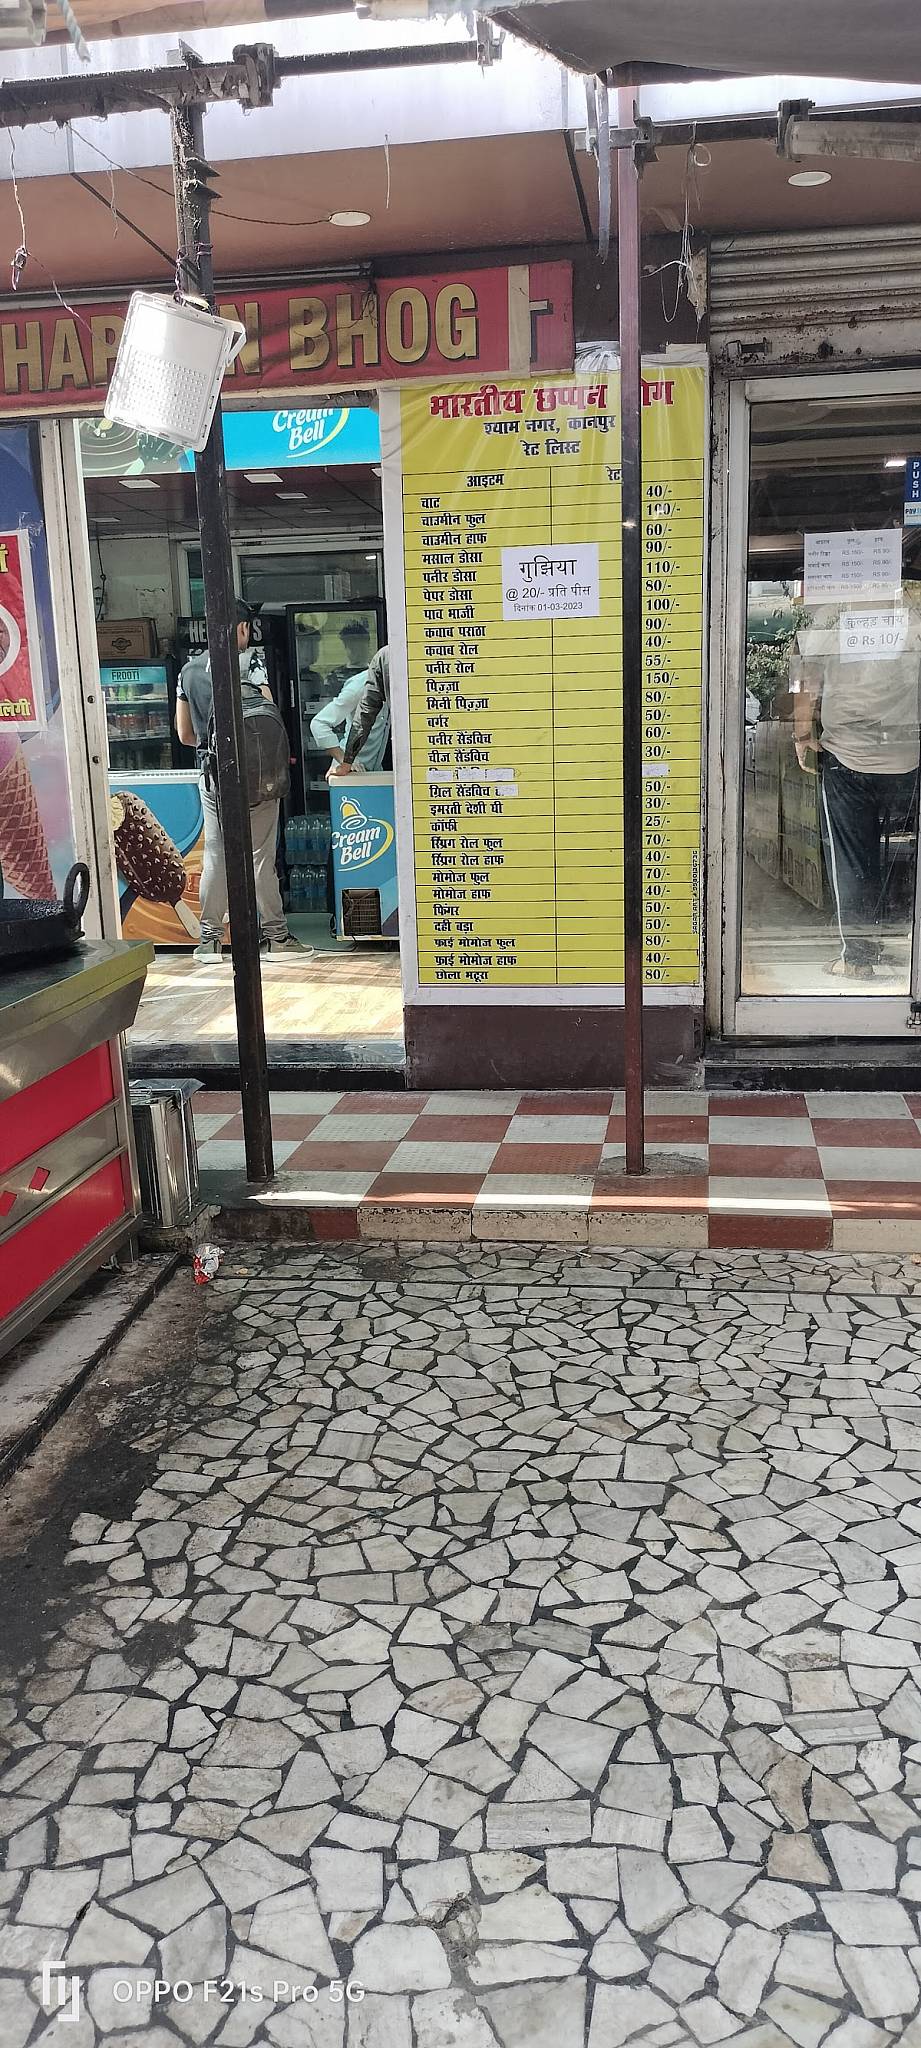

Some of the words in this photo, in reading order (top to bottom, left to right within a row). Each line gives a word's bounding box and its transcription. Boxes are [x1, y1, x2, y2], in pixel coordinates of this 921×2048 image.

[1, 302, 261, 393] HAPN
[288, 282, 480, 372] BHOG
[430, 383, 525, 420] भारतीय
[534, 382, 608, 413] छप्पन
[484, 420, 519, 437] श्याम
[525, 418, 561, 437] नगर,
[567, 415, 617, 435] कानपुर
[289, 420, 325, 451] Bell
[521, 440, 540, 457] रेट
[546, 438, 581, 455] लिस्ट
[467, 473, 505, 489] आइटम
[912, 461, 920, 498] PUSH
[645, 484, 672, 499] 40/-
[421, 513, 461, 527] चाउमीन
[464, 513, 486, 528] फुल
[645, 524, 672, 538] 60/-
[422, 532, 462, 546] चाउमीन
[466, 533, 487, 545] हाफ
[645, 540, 672, 556] 90/-
[458, 550, 483, 564] डोसा
[519, 555, 578, 583] गुझिया
[645, 560, 680, 576] 110/-
[423, 569, 448, 584] पनीर
[452, 569, 477, 582] डोसा
[423, 589, 444, 602] पेपर
[449, 587, 473, 601] डोसा
[506, 588, 519, 602] @
[522, 587, 545, 599] 20/-
[548, 584, 568, 597] प्रति
[571, 582, 591, 596] पीस
[645, 579, 672, 595] 80/-
[424, 609, 443, 620] पाव
[448, 606, 475, 619] भाजी
[514, 603, 537, 612] दिनांक
[538, 602, 583, 611] 01-03-2023
[645, 598, 680, 613] 100/-
[458, 626, 486, 638] पराठा
[645, 618, 672, 633] 90/-
[645, 636, 672, 650] 40/-
[847, 636, 858, 648] @
[862, 636, 876, 646] Rs
[880, 632, 904, 646] 10/-
[459, 642, 479, 655] रोल
[425, 661, 451, 674] पनीर
[455, 660, 475, 674] रोल
[645, 654, 671, 669] 55/-
[112, 670, 140, 681] FROOTI
[645, 672, 680, 687] 150/-
[426, 697, 452, 711] मिनी
[645, 691, 671, 706] 80/-
[645, 709, 671, 724] 50/-
[427, 733, 453, 746] पनीर
[457, 731, 493, 745] सैंडविच
[645, 726, 671, 741] 60/-
[428, 750, 451, 763] चीज
[454, 749, 490, 762] सैंडविच
[645, 745, 671, 760] 30/-
[429, 785, 452, 798] ग्रिल
[456, 784, 493, 797] सैंडविच
[645, 780, 671, 794] 50/-
[430, 802, 462, 816] इमरती
[466, 801, 486, 815] देशी
[491, 801, 504, 814] घी
[645, 797, 671, 812] 30/-
[430, 819, 458, 832] कॉफी
[645, 816, 671, 830] 25/-
[332, 826, 381, 850] Cream
[460, 836, 479, 849] रोल
[483, 838, 503, 852] फुल
[645, 833, 671, 848] 70/-
[341, 842, 372, 865] Bell
[460, 852, 479, 866] रोल
[483, 855, 504, 866] हाफ
[645, 850, 671, 865] 40/-
[432, 870, 466, 883] मोमोज
[470, 872, 490, 885] फुल
[645, 868, 671, 882] 70/-
[432, 887, 467, 900] मोमोज
[471, 890, 491, 900] हाफ
[645, 885, 671, 898] 40/-
[433, 903, 460, 916] फिंगर
[645, 902, 670, 916] 50/-
[433, 919, 451, 932] दही
[645, 919, 670, 932] 50/-
[458, 936, 492, 948] मोमोज
[496, 939, 516, 950] फुल
[645, 935, 670, 949] 80/-
[458, 953, 493, 966] मोमोज
[496, 956, 517, 966] हाफ
[645, 952, 670, 966] 40/-
[435, 969, 461, 980] छोला
[645, 969, 670, 982] 80/-
